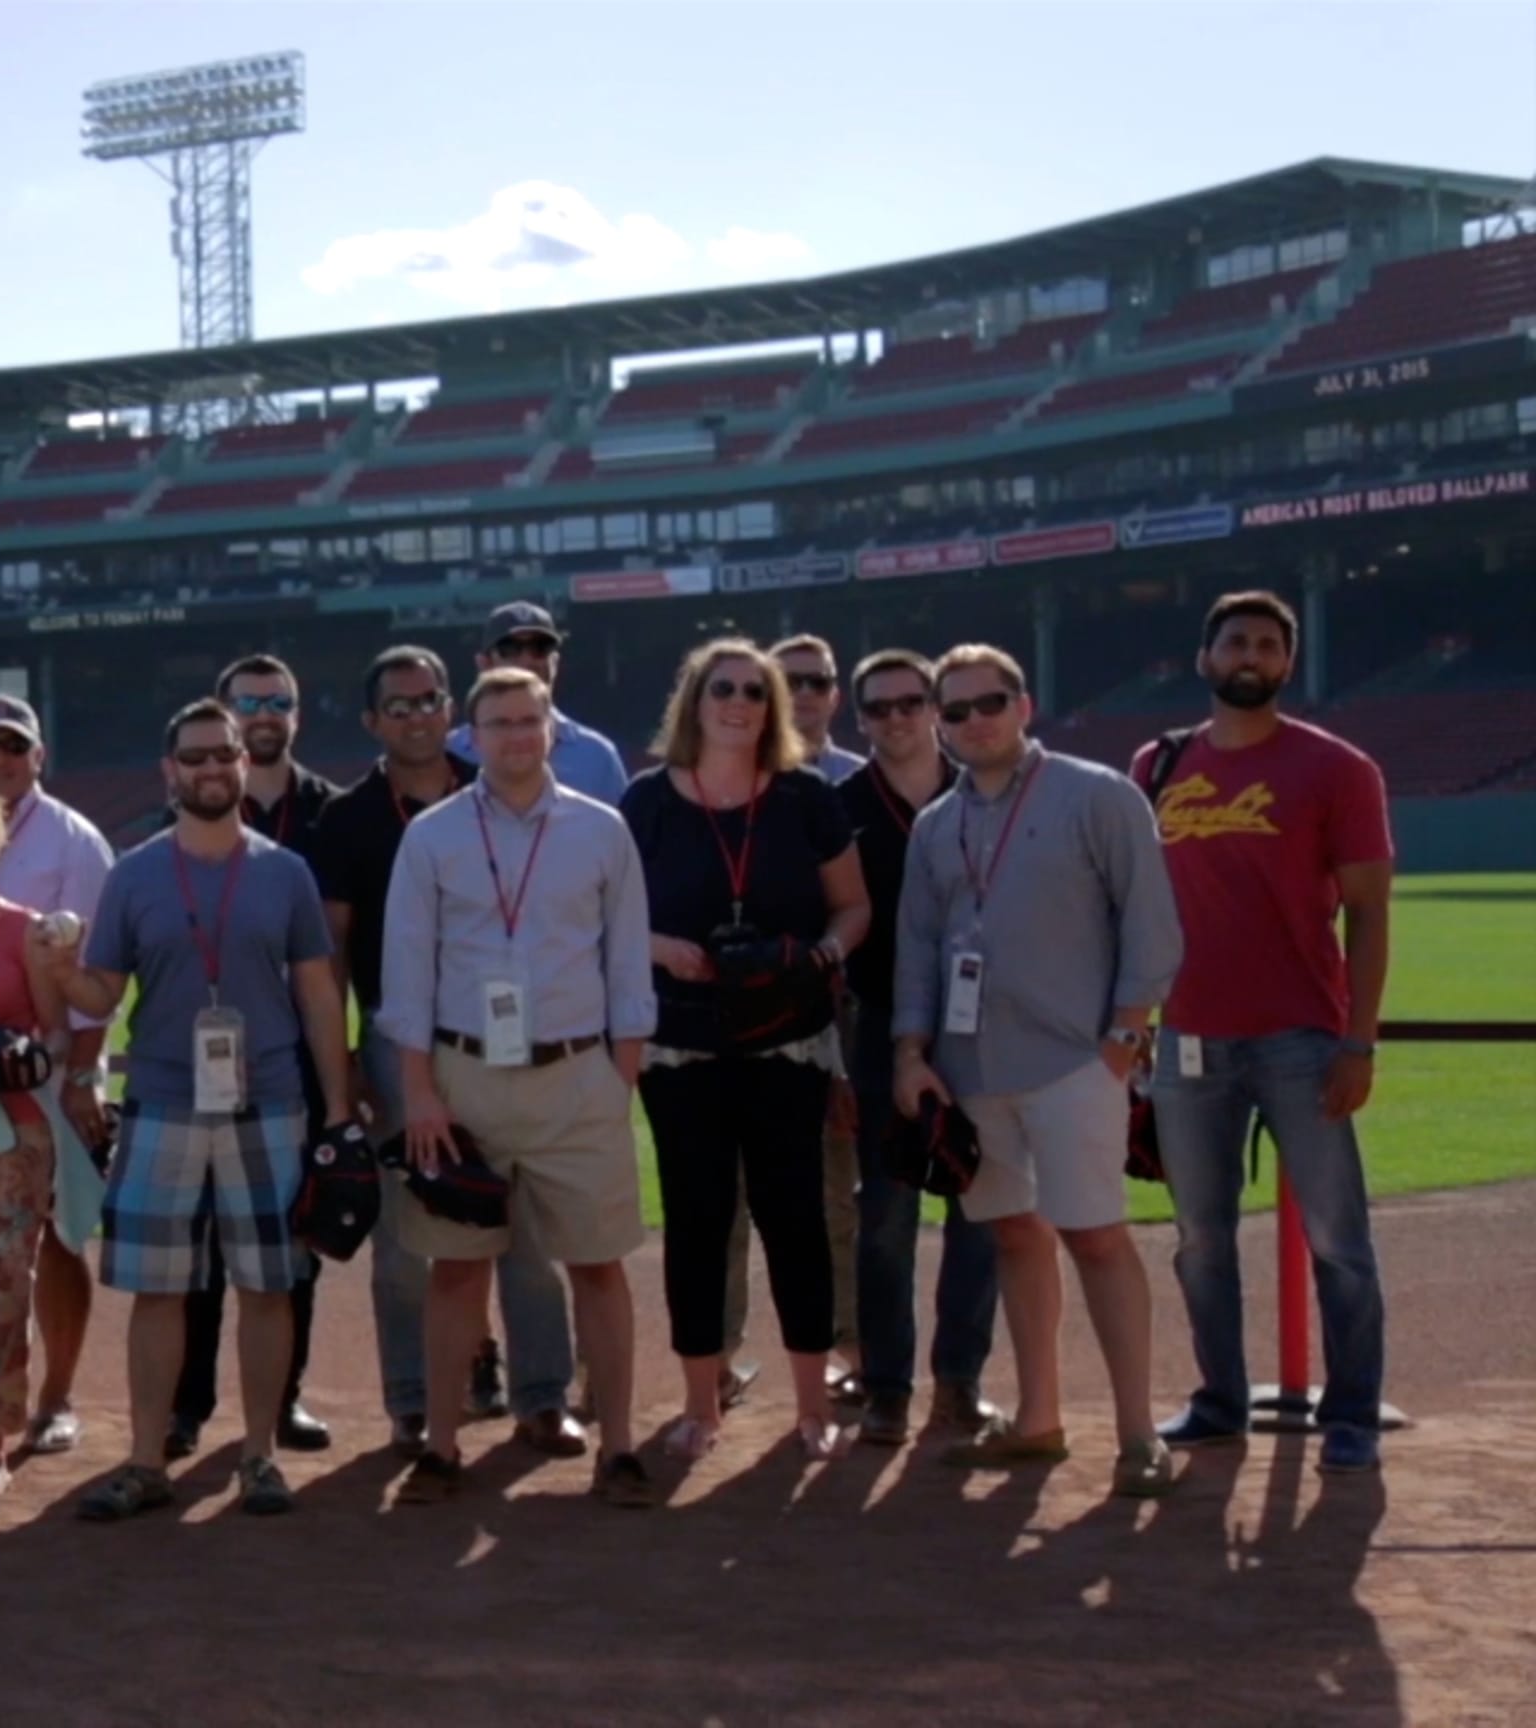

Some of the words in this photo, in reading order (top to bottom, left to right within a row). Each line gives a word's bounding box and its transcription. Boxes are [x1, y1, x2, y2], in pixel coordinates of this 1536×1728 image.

[1313, 371, 1353, 397] JULY
[1389, 357, 1431, 385] 2015
[1241, 499, 1319, 527] AMERICA'S
[1321, 492, 1362, 515] MOST
[1367, 483, 1437, 511] BELOVED
[1441, 471, 1530, 501] BALLPARK
